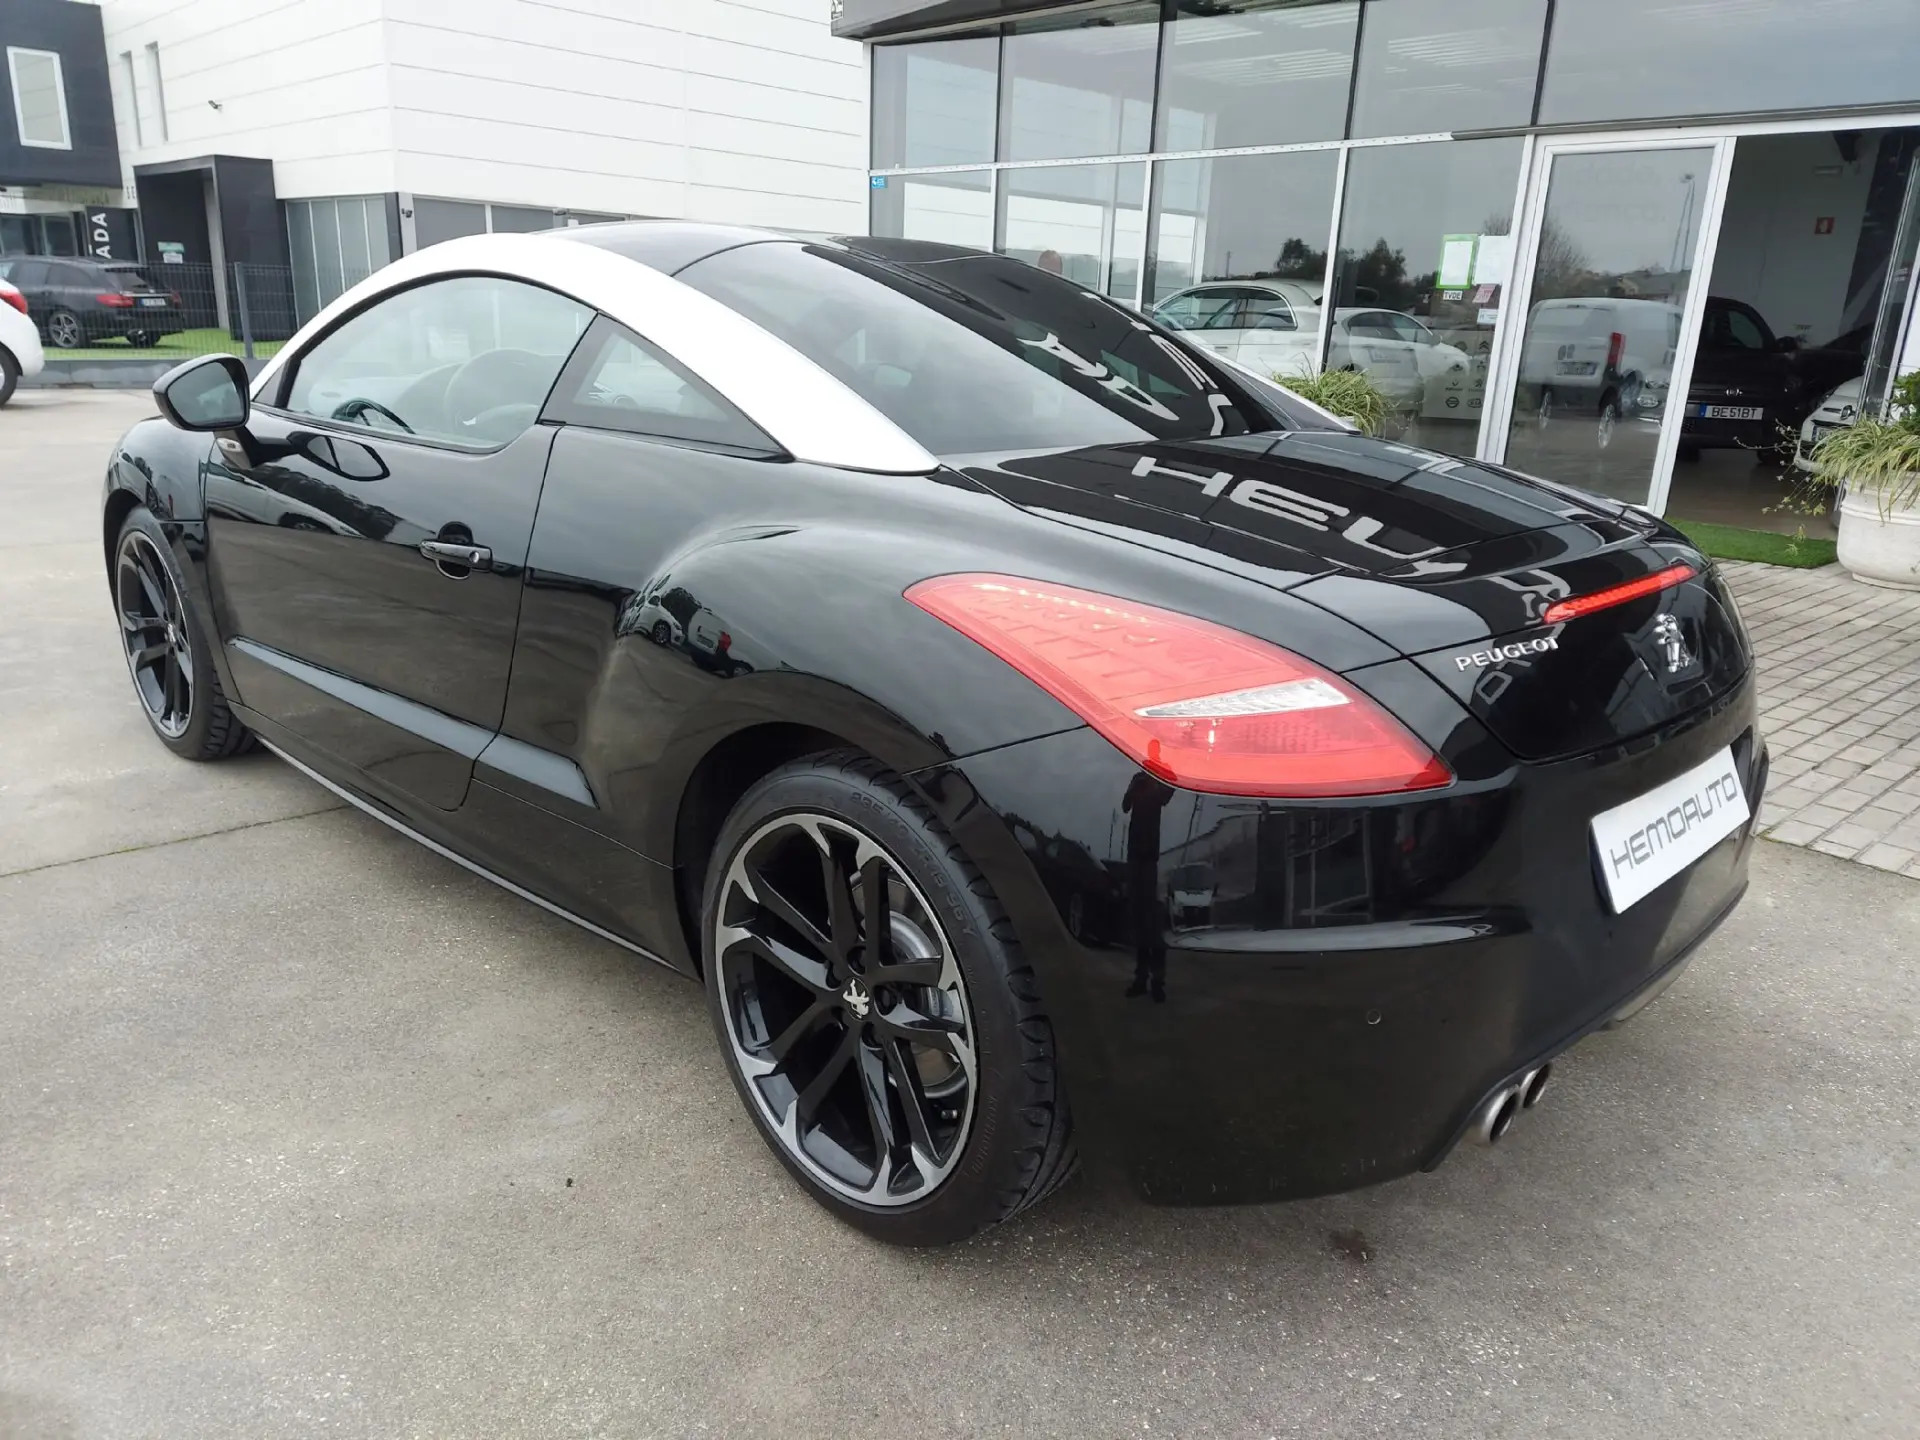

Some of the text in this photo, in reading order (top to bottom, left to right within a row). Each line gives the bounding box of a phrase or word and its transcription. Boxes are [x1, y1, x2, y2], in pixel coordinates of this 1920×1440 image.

[1444, 291, 1461, 299] TVDE
[1455, 637, 1559, 671] PEUGEOT
[1610, 772, 1738, 878] HEMOAUTO
